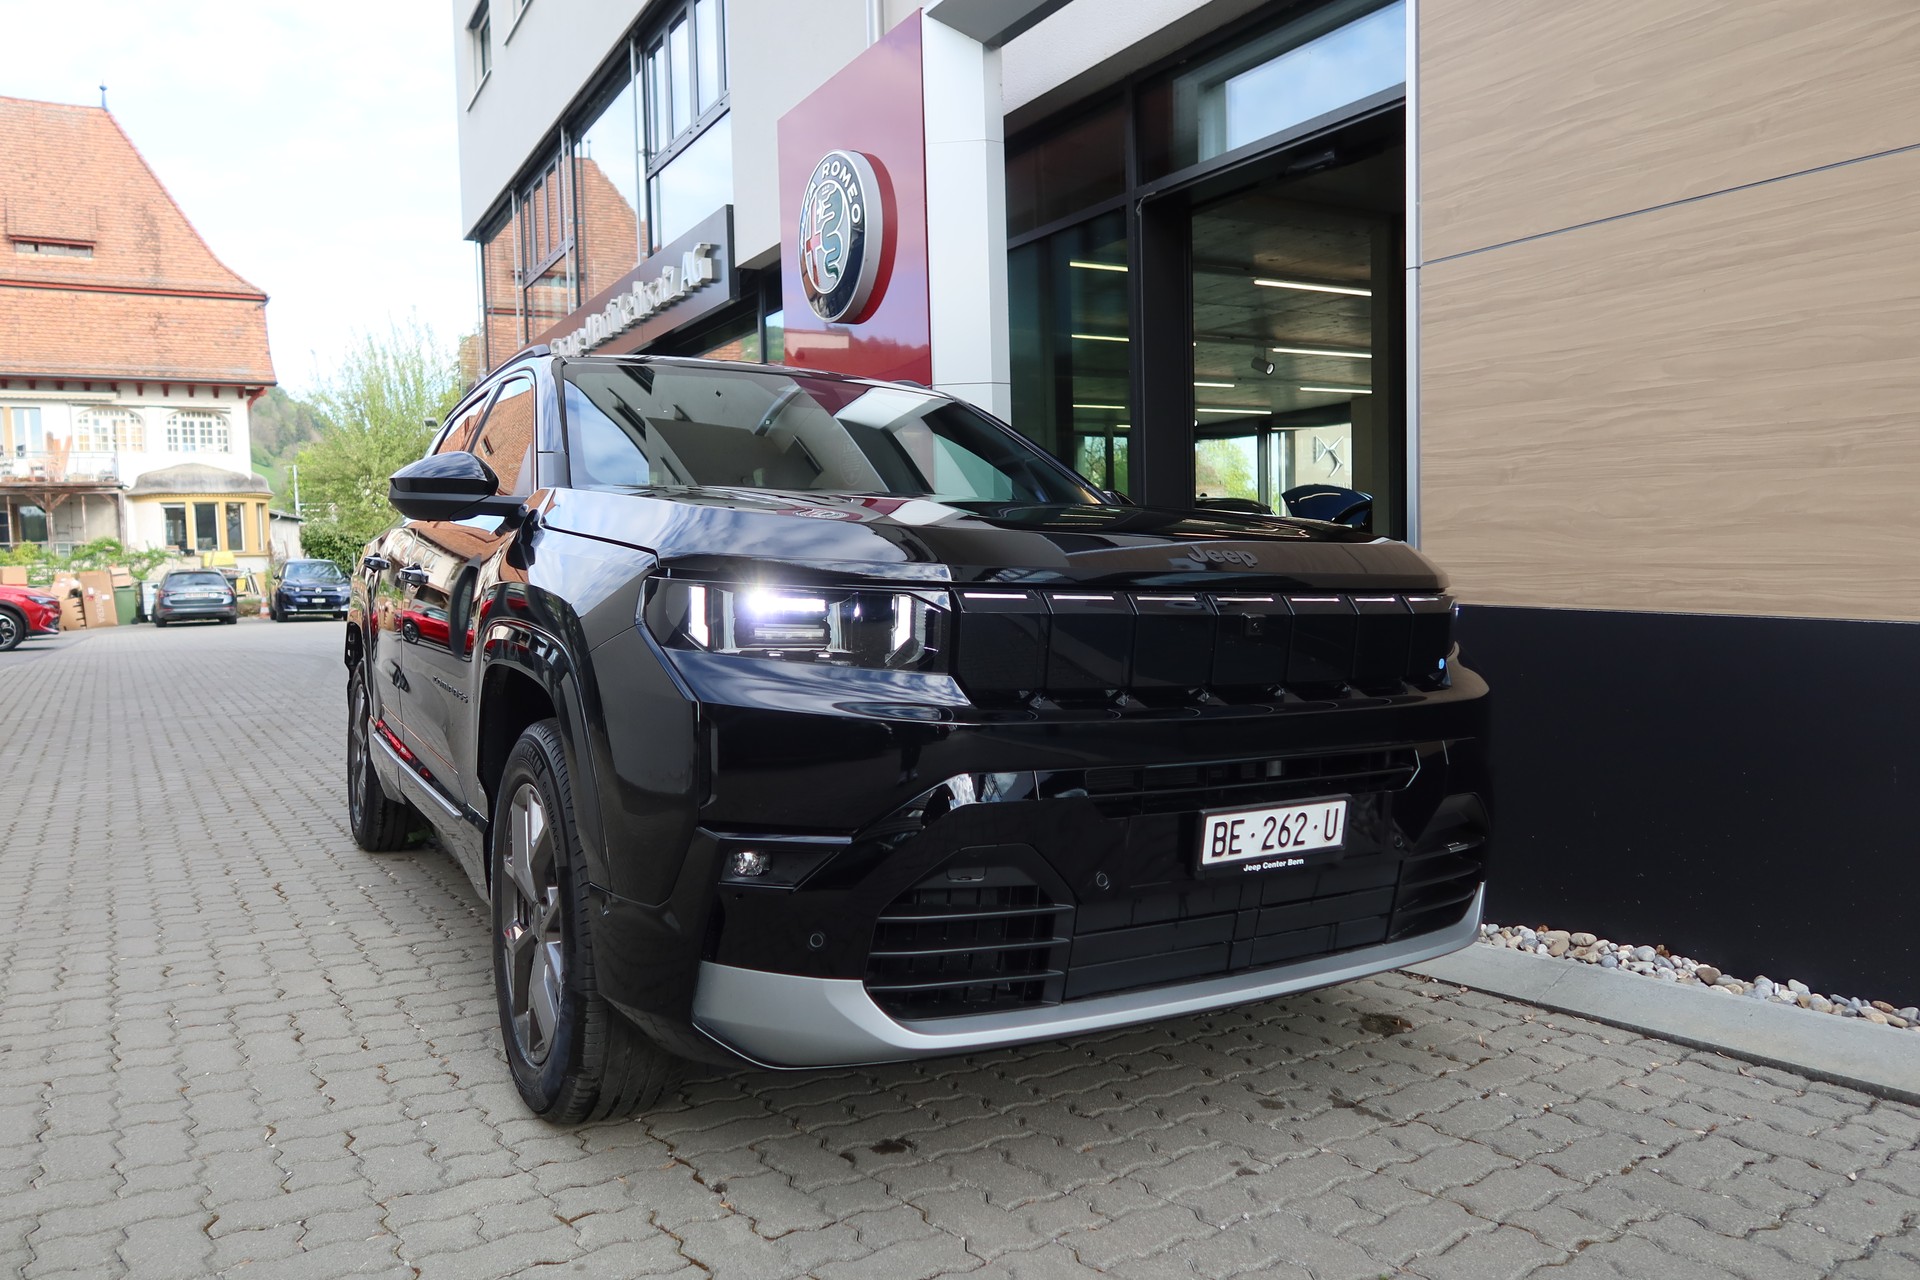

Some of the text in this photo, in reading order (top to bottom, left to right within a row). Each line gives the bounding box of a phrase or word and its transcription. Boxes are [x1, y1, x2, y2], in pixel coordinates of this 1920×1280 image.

[821, 160, 862, 224] ROMEO
[680, 242, 713, 292] AG
[1187, 545, 1258, 568] Jeep
[1243, 858, 1304, 872] Jeep Center Bern
